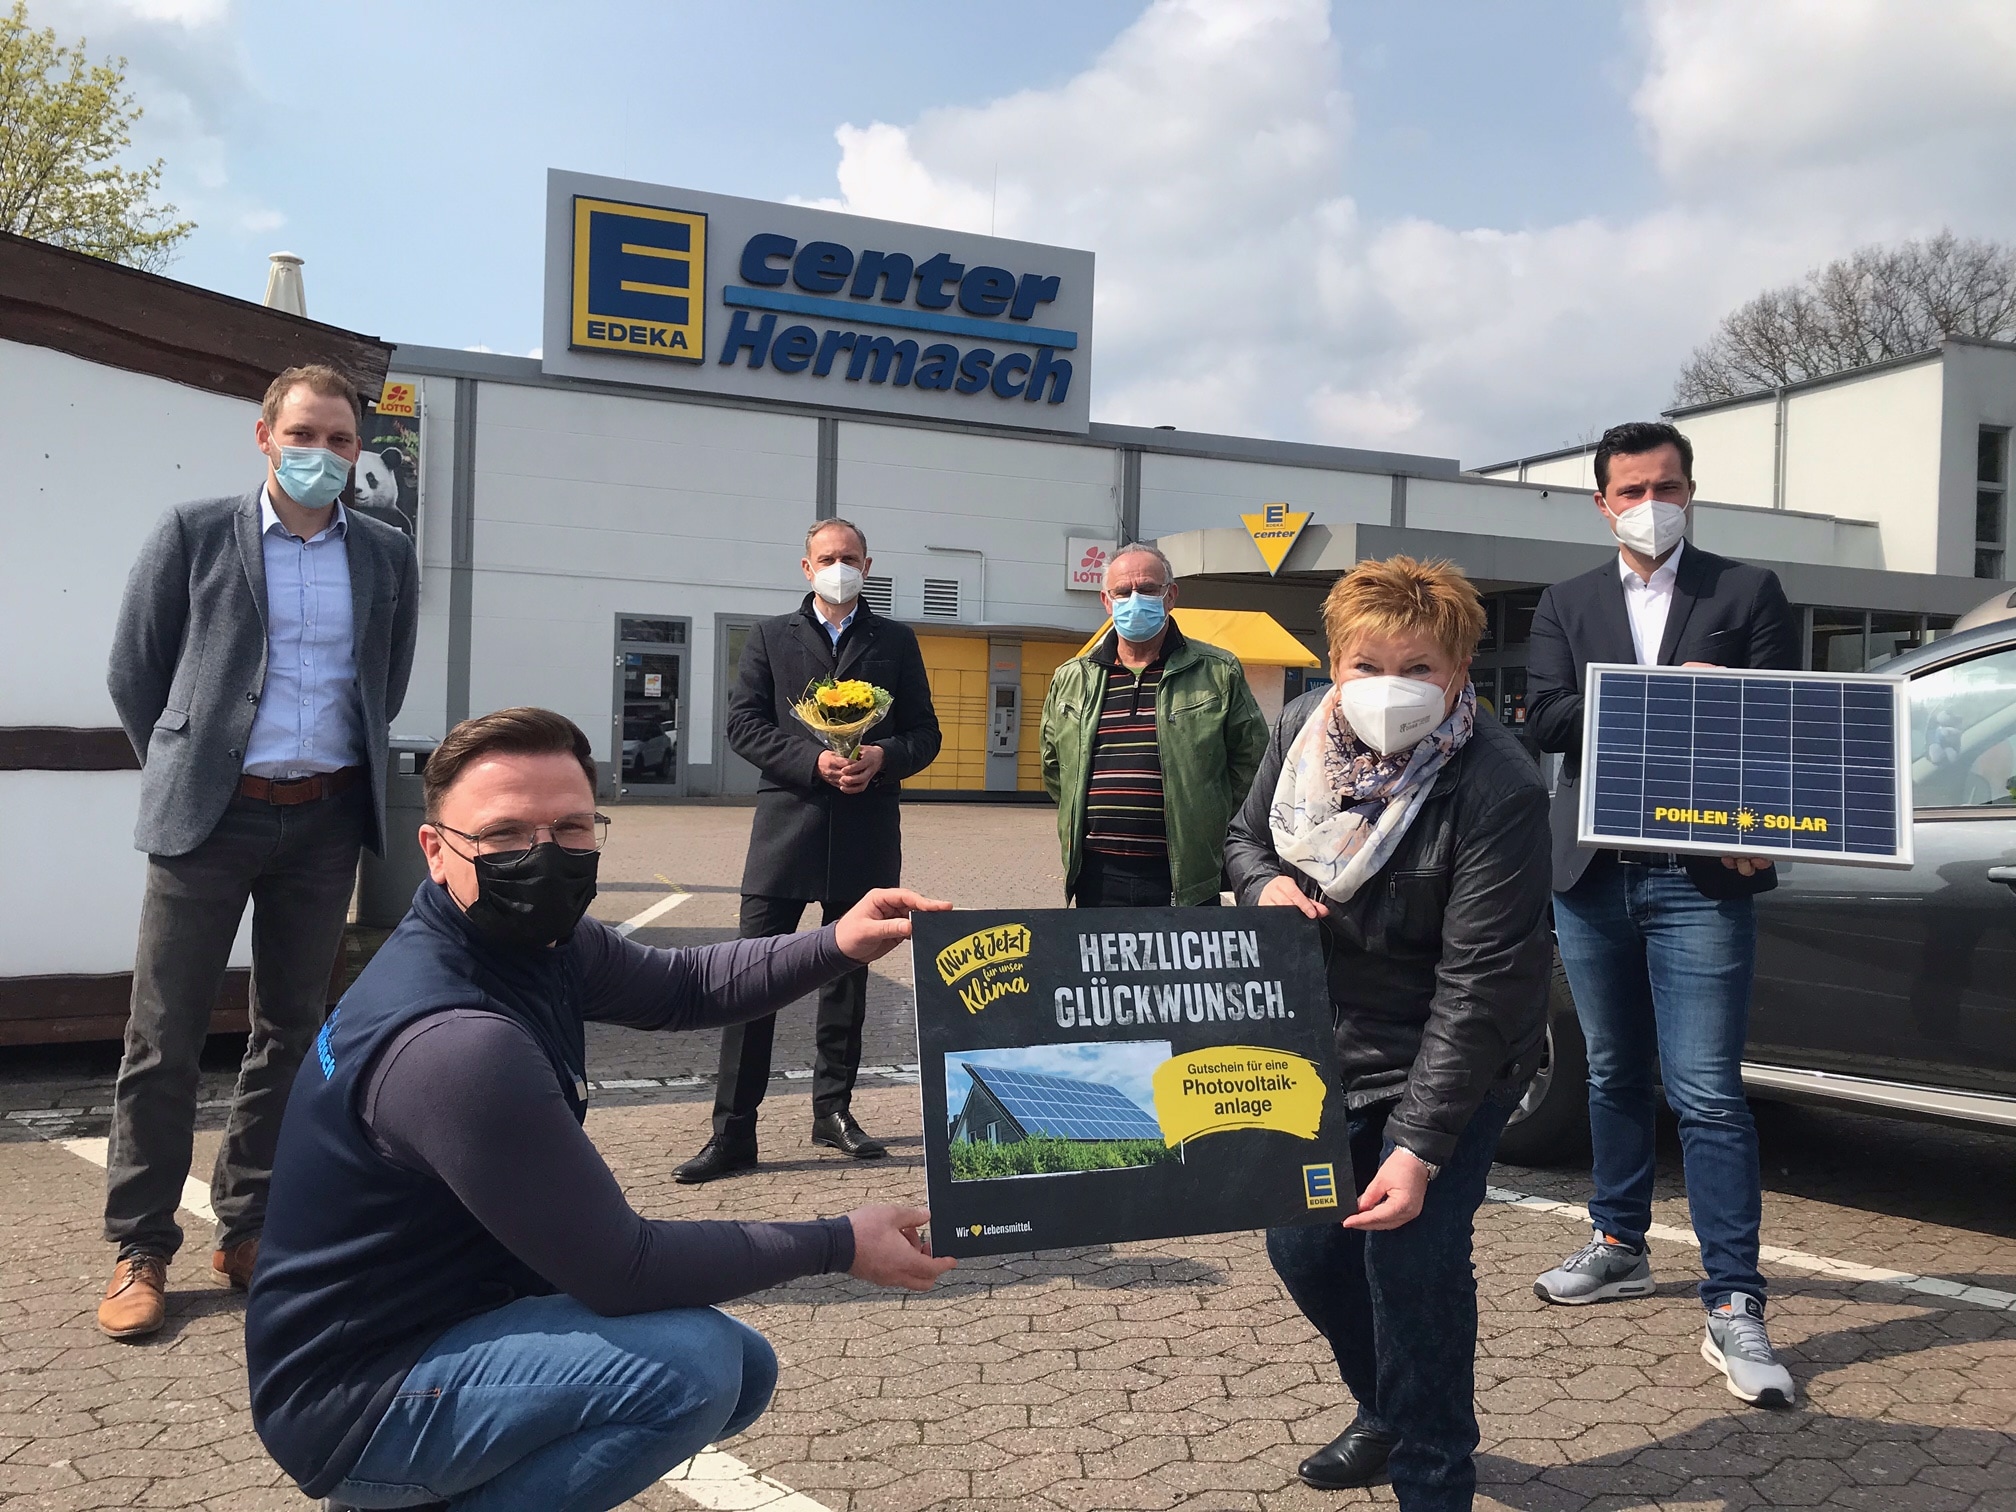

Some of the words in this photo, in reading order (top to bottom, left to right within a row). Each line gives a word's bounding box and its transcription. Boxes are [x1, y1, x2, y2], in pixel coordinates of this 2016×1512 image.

[589, 210, 690, 326] E
[740, 232, 1061, 320] center
[587, 320, 689, 350] EDEKA
[720, 310, 1074, 404] Hermasch
[381, 402, 412, 414] LOTTO
[1266, 506, 1283, 523] E
[1253, 530, 1296, 539] center
[1073, 571, 1102, 583] LOTT
[1655, 807, 1727, 826] POHLEN
[1764, 814, 1827, 832] SOLAR
[939, 948, 972, 978] Wir
[972, 935, 987, 960] &
[985, 928, 1027, 957] Jetzt
[1078, 930, 1260, 973] HERZLICHEN
[983, 966, 998, 981] für
[998, 962, 1024, 973] unser
[959, 976, 1030, 1015] Klima
[1054, 976, 1295, 1028] GLÜCKWUNSCH.
[1187, 1061, 1244, 1075] Gutschein
[1247, 1060, 1262, 1071] für
[1265, 1060, 1289, 1071] eine
[1182, 1074, 1297, 1096] Photovoltaik-
[1214, 1097, 1272, 1117] anlage
[1306, 1168, 1333, 1197] E
[1309, 1198, 1335, 1206] EDEKA
[955, 1226, 970, 1238] Wir
[983, 1220, 1033, 1236] Lebensmittel.
